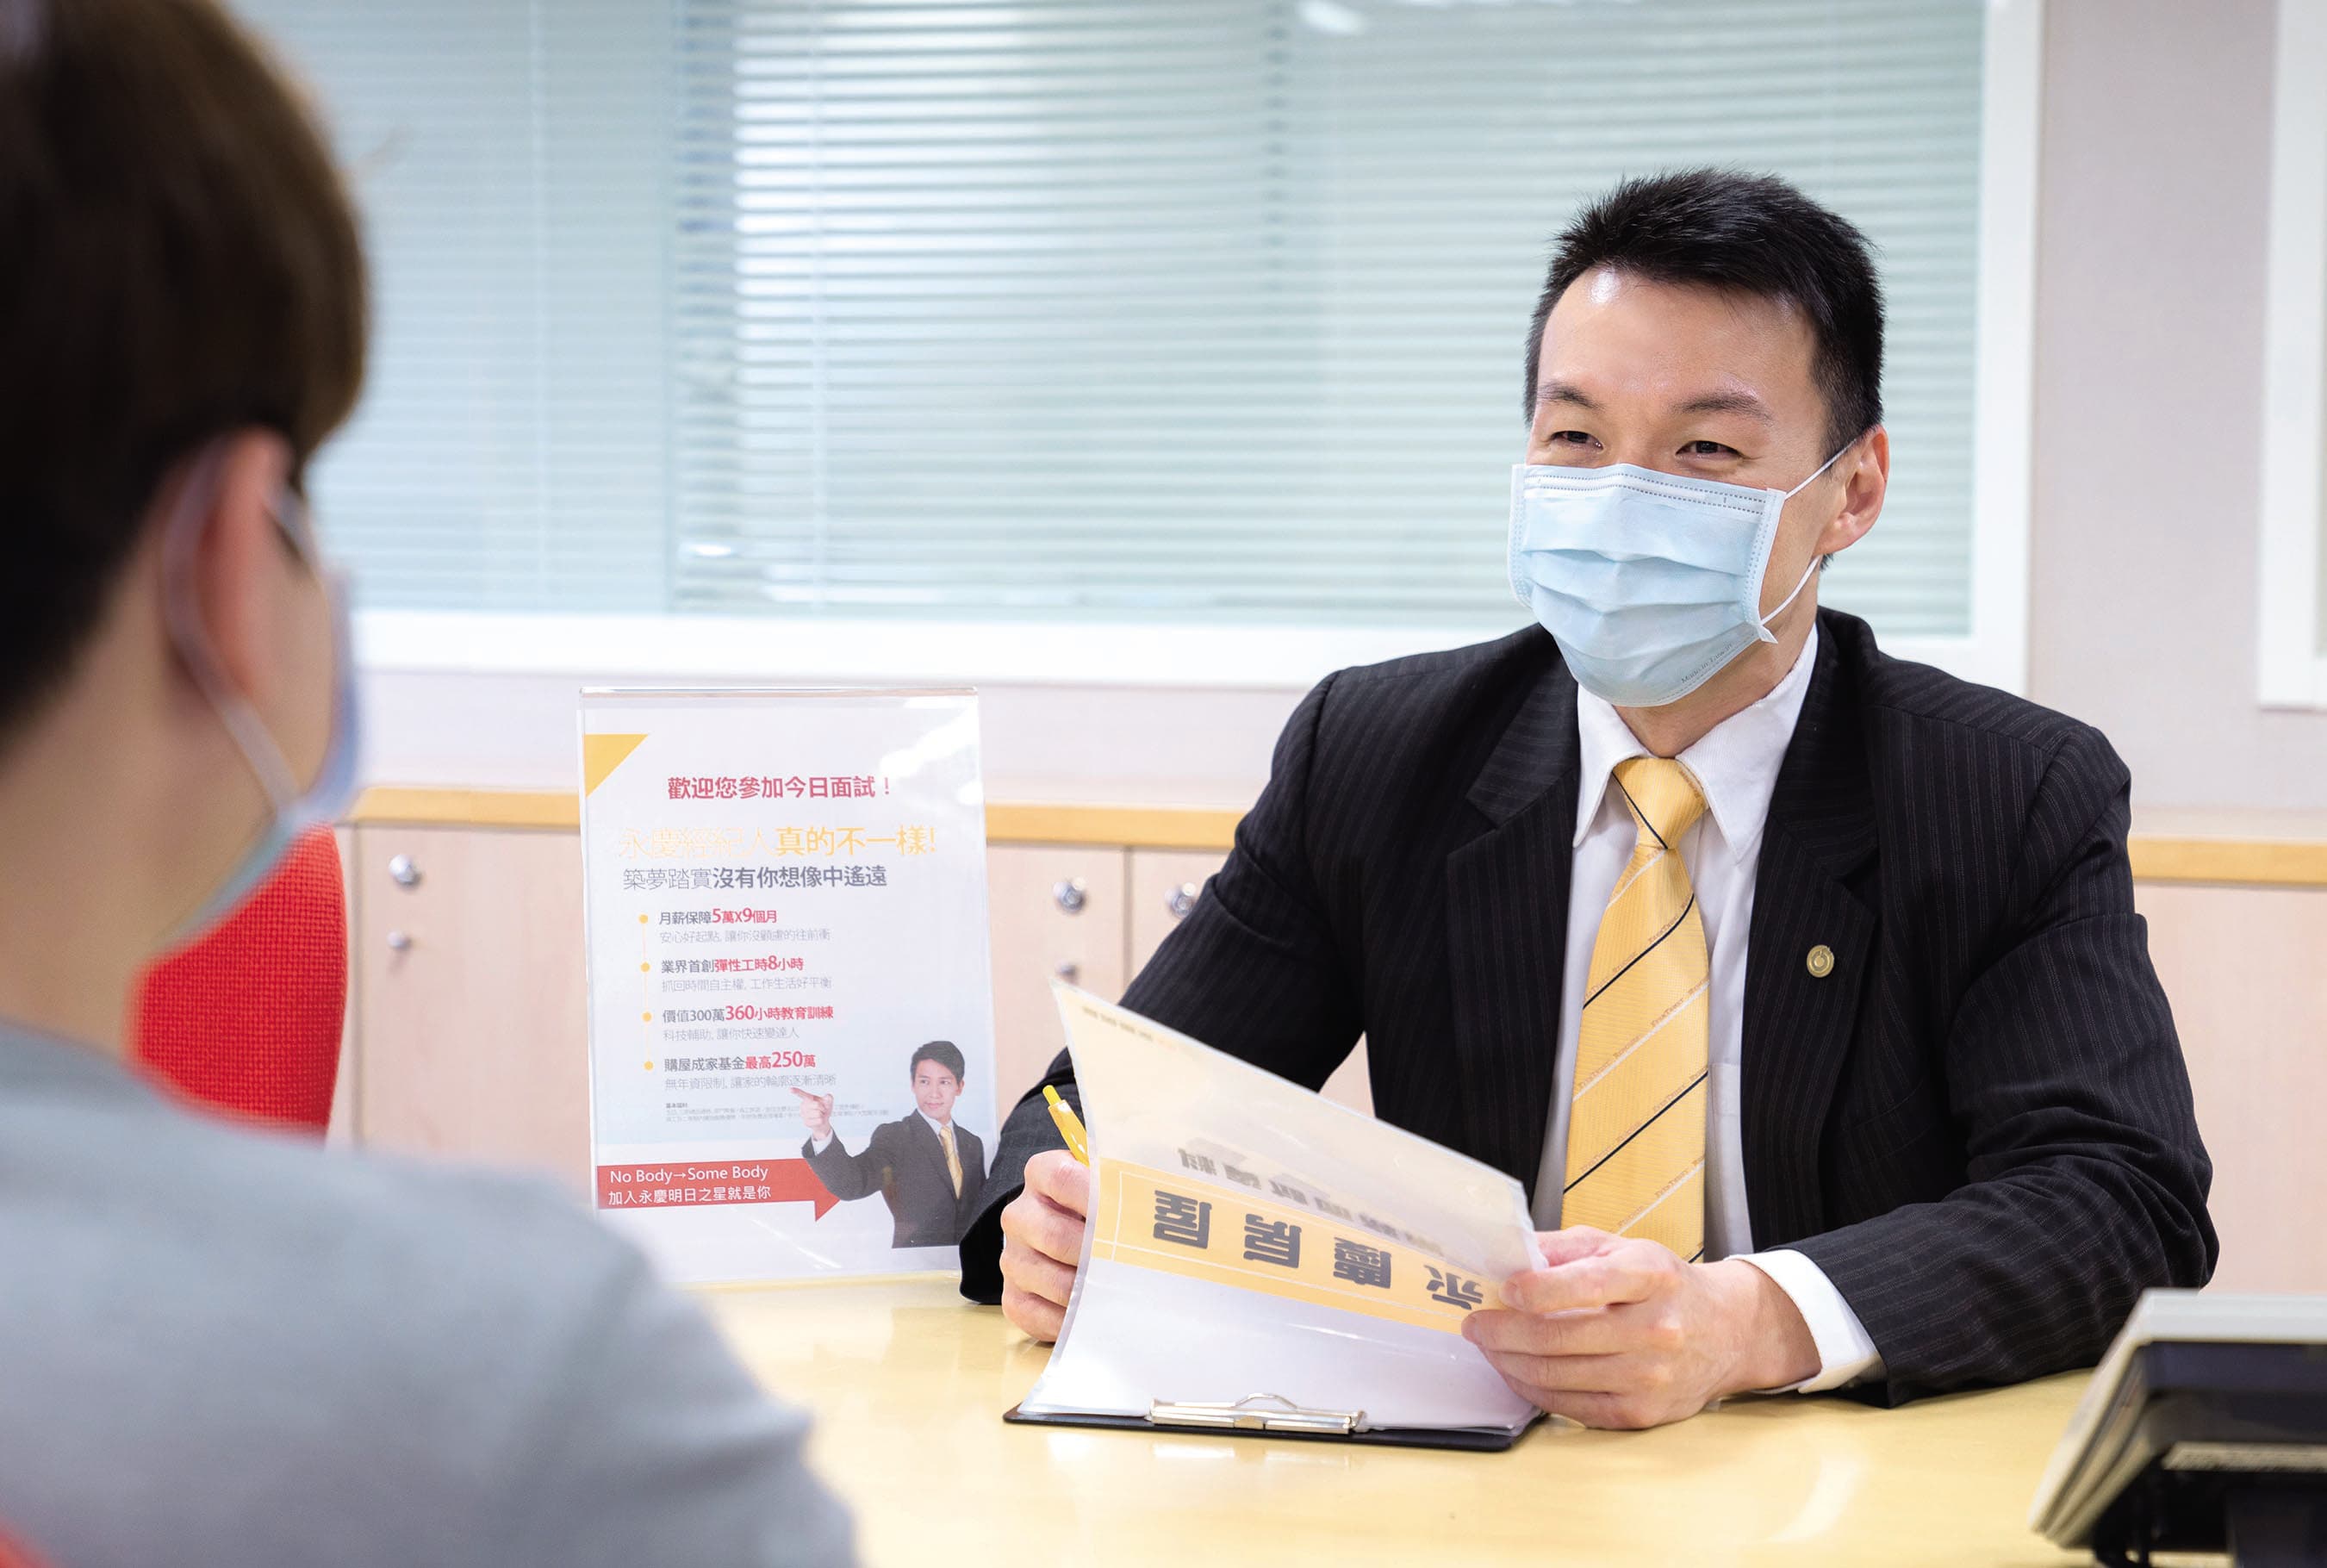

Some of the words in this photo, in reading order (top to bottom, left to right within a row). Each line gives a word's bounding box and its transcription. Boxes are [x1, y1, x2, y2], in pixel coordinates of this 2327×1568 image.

[668, 775, 890, 800] 歡迎您參加今日面試！
[622, 864, 887, 891] 築夢踏實沒有你想像中遙遠
[661, 955, 805, 974] 業界首創彈性工時8小時
[664, 1050, 817, 1073] 購屋成家基金最高250萬
[610, 1170, 632, 1184] No
[732, 1165, 768, 1181] Body
[1153, 1189, 1484, 1310] 永慶房屋
